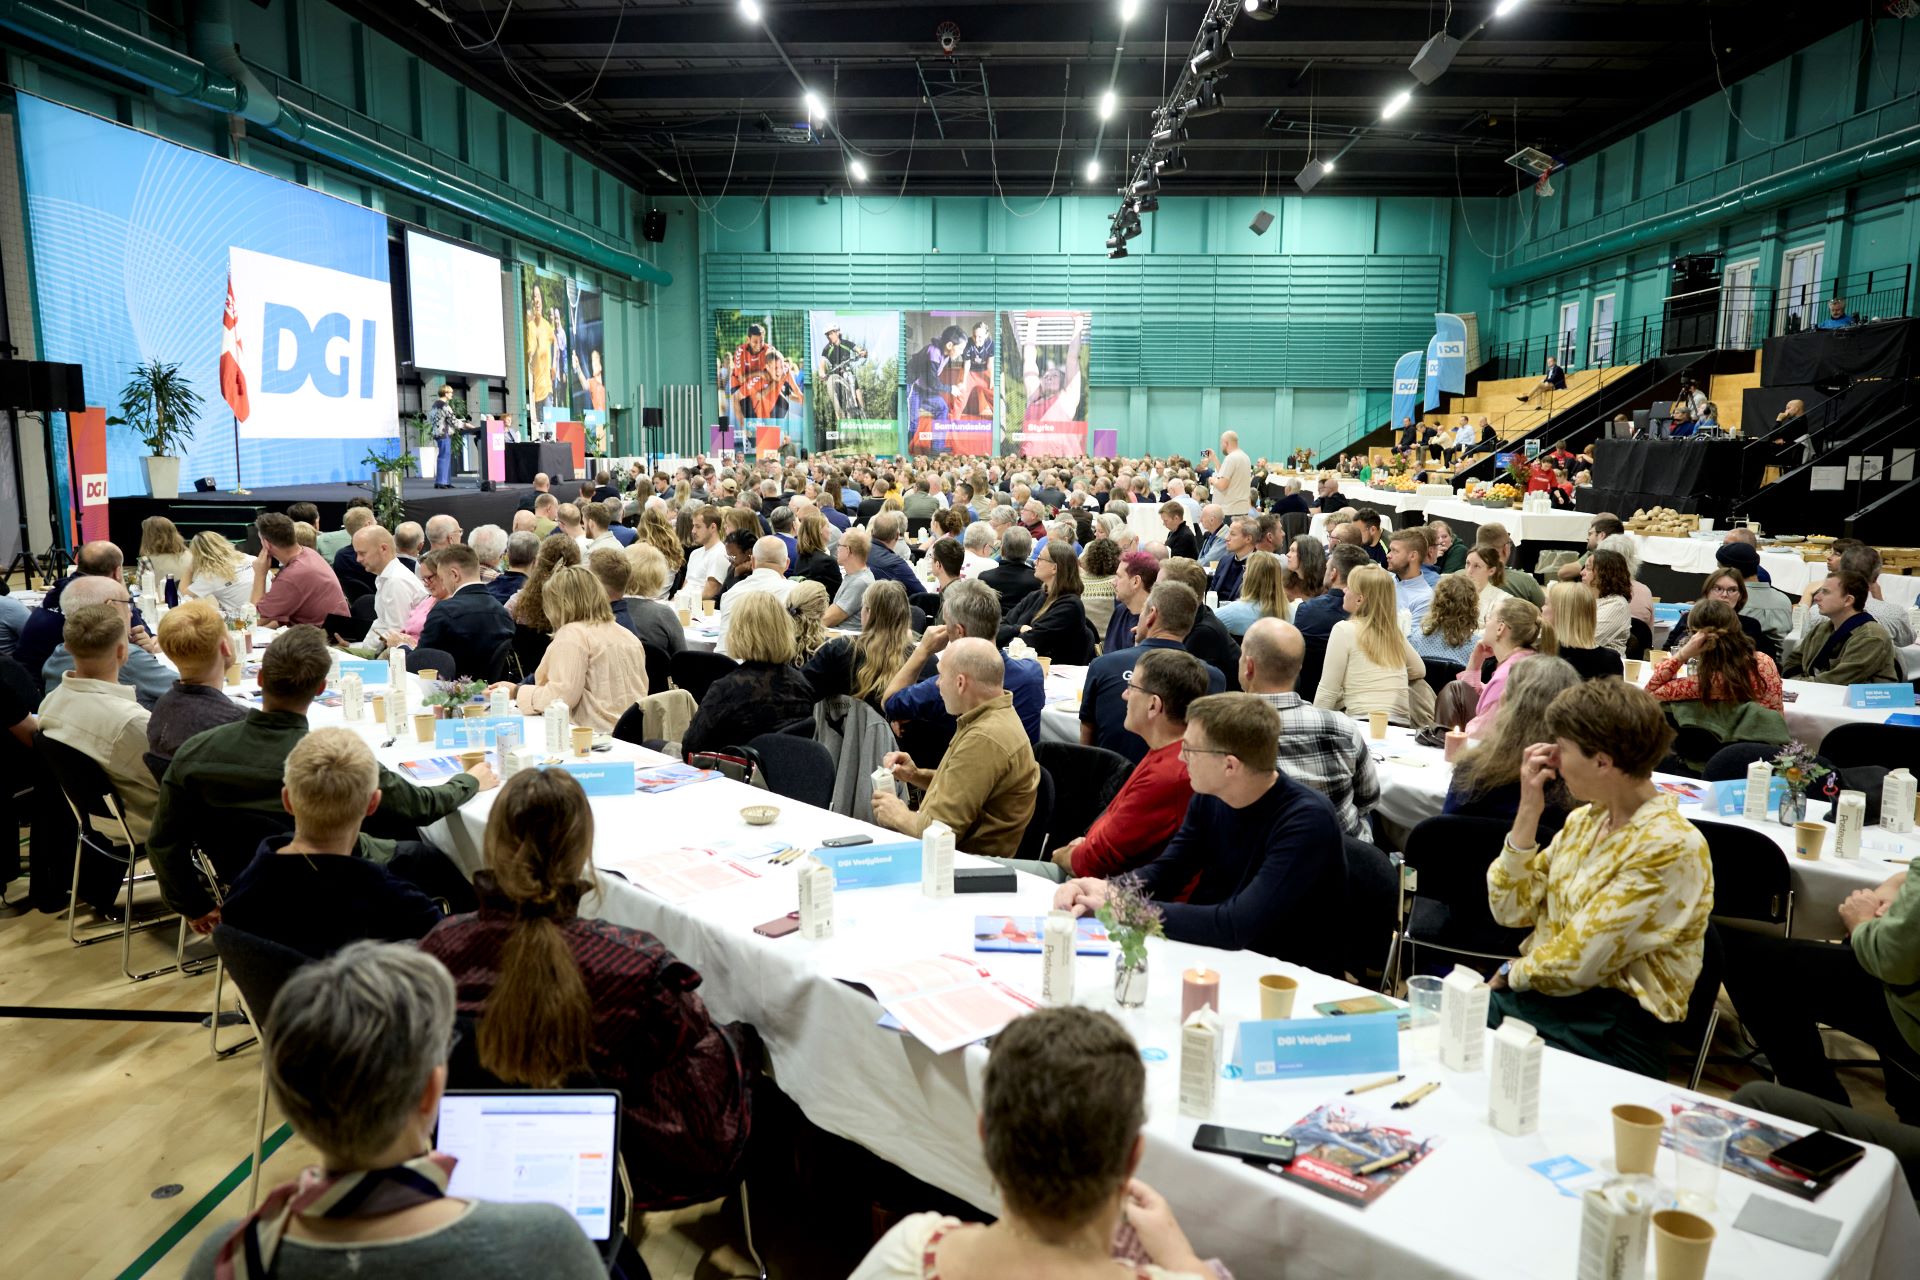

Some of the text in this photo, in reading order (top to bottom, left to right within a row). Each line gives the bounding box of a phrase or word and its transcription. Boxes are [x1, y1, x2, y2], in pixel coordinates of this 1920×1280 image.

[261, 302, 376, 399] DGI
[1398, 382, 1417, 391] DGI
[840, 421, 892, 430] Målrettethed
[934, 422, 992, 431] Samfundssind
[1027, 423, 1055, 433] Styrke
[86, 481, 107, 498] DGI
[1835, 814, 1848, 858] Postevand
[1042, 944, 1054, 999] Postevand
[1277, 1032, 1352, 1047] DGI Vestjylland
[1297, 1159, 1368, 1192] Program
